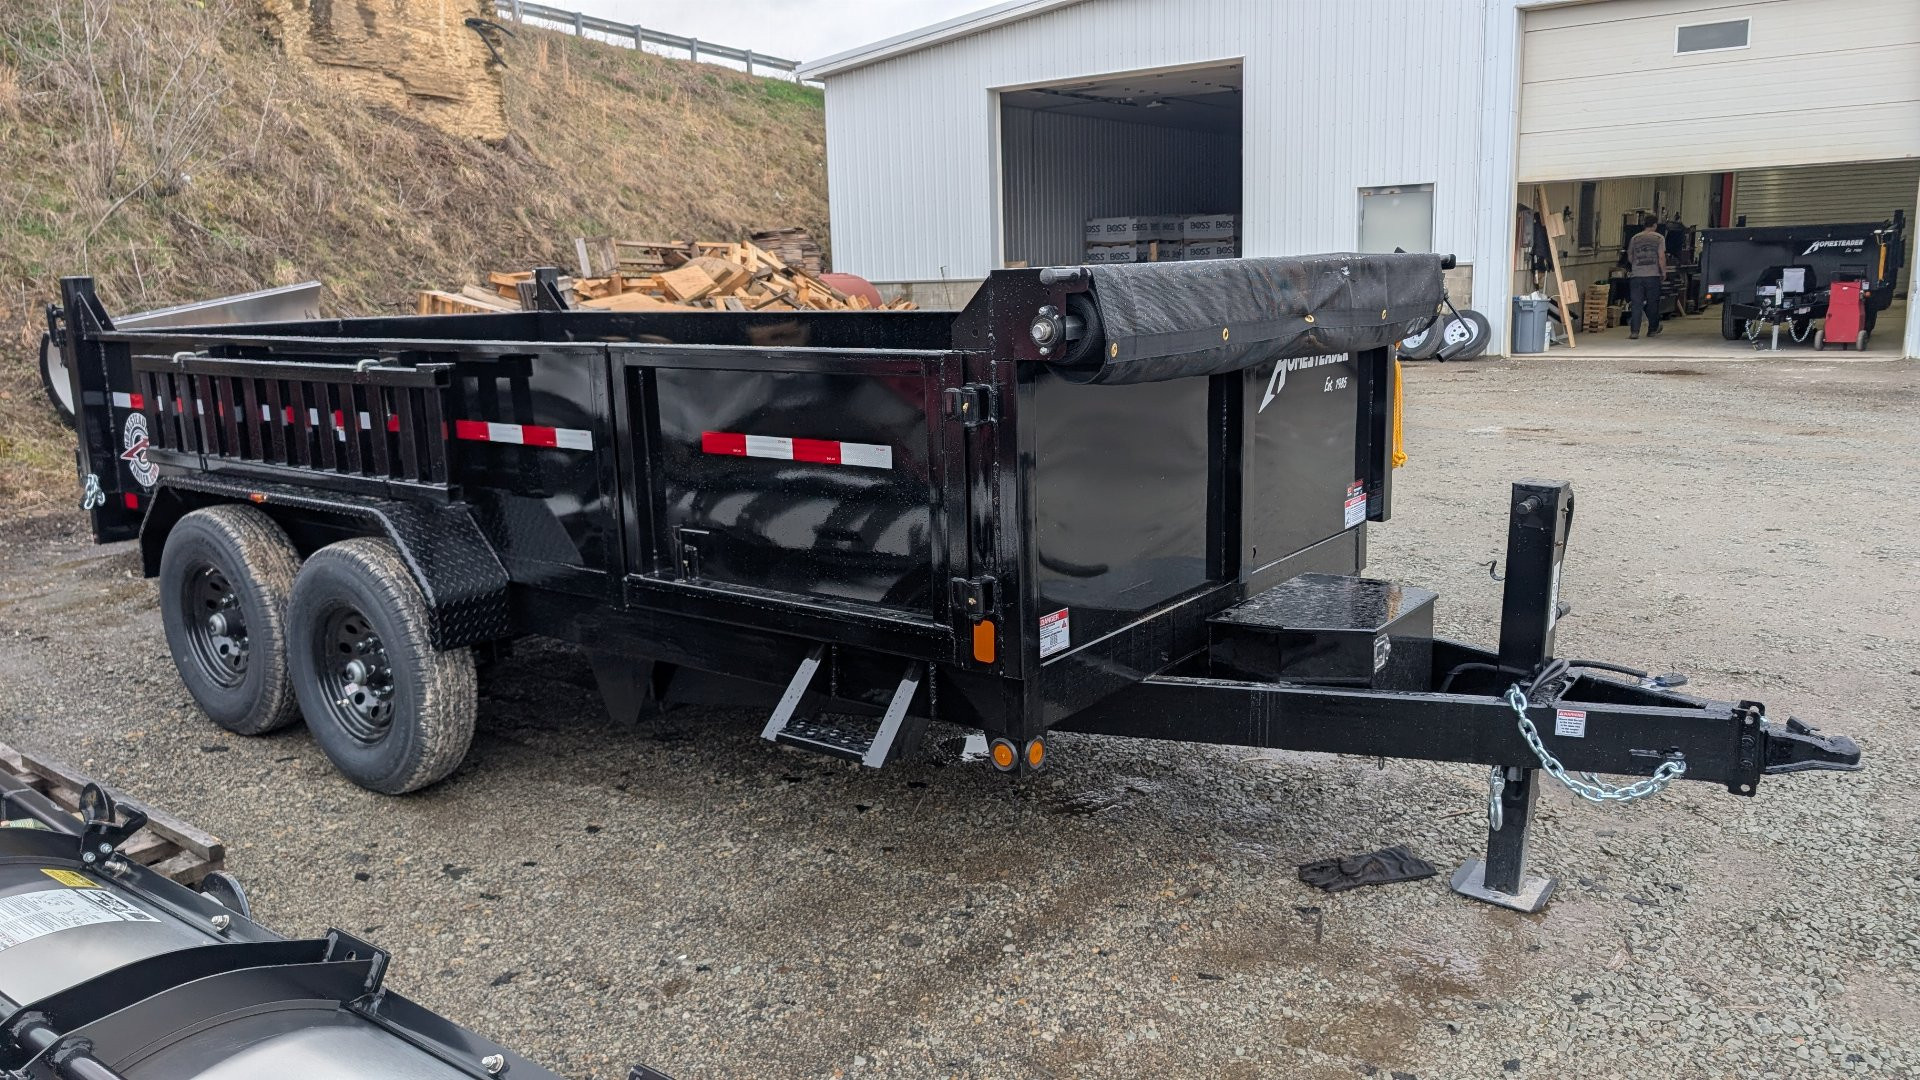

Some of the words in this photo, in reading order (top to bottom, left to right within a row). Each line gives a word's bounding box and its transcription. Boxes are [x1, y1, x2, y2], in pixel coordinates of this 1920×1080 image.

[1106, 224, 1127, 233] BOSS
[1190, 221, 1211, 230] BOSS
[1190, 247, 1211, 256] BOSS
[1802, 239, 1865, 256] HOMESTEADER
[1109, 252, 1130, 261] BOSS
[1040, 614, 1060, 625] DANGER
